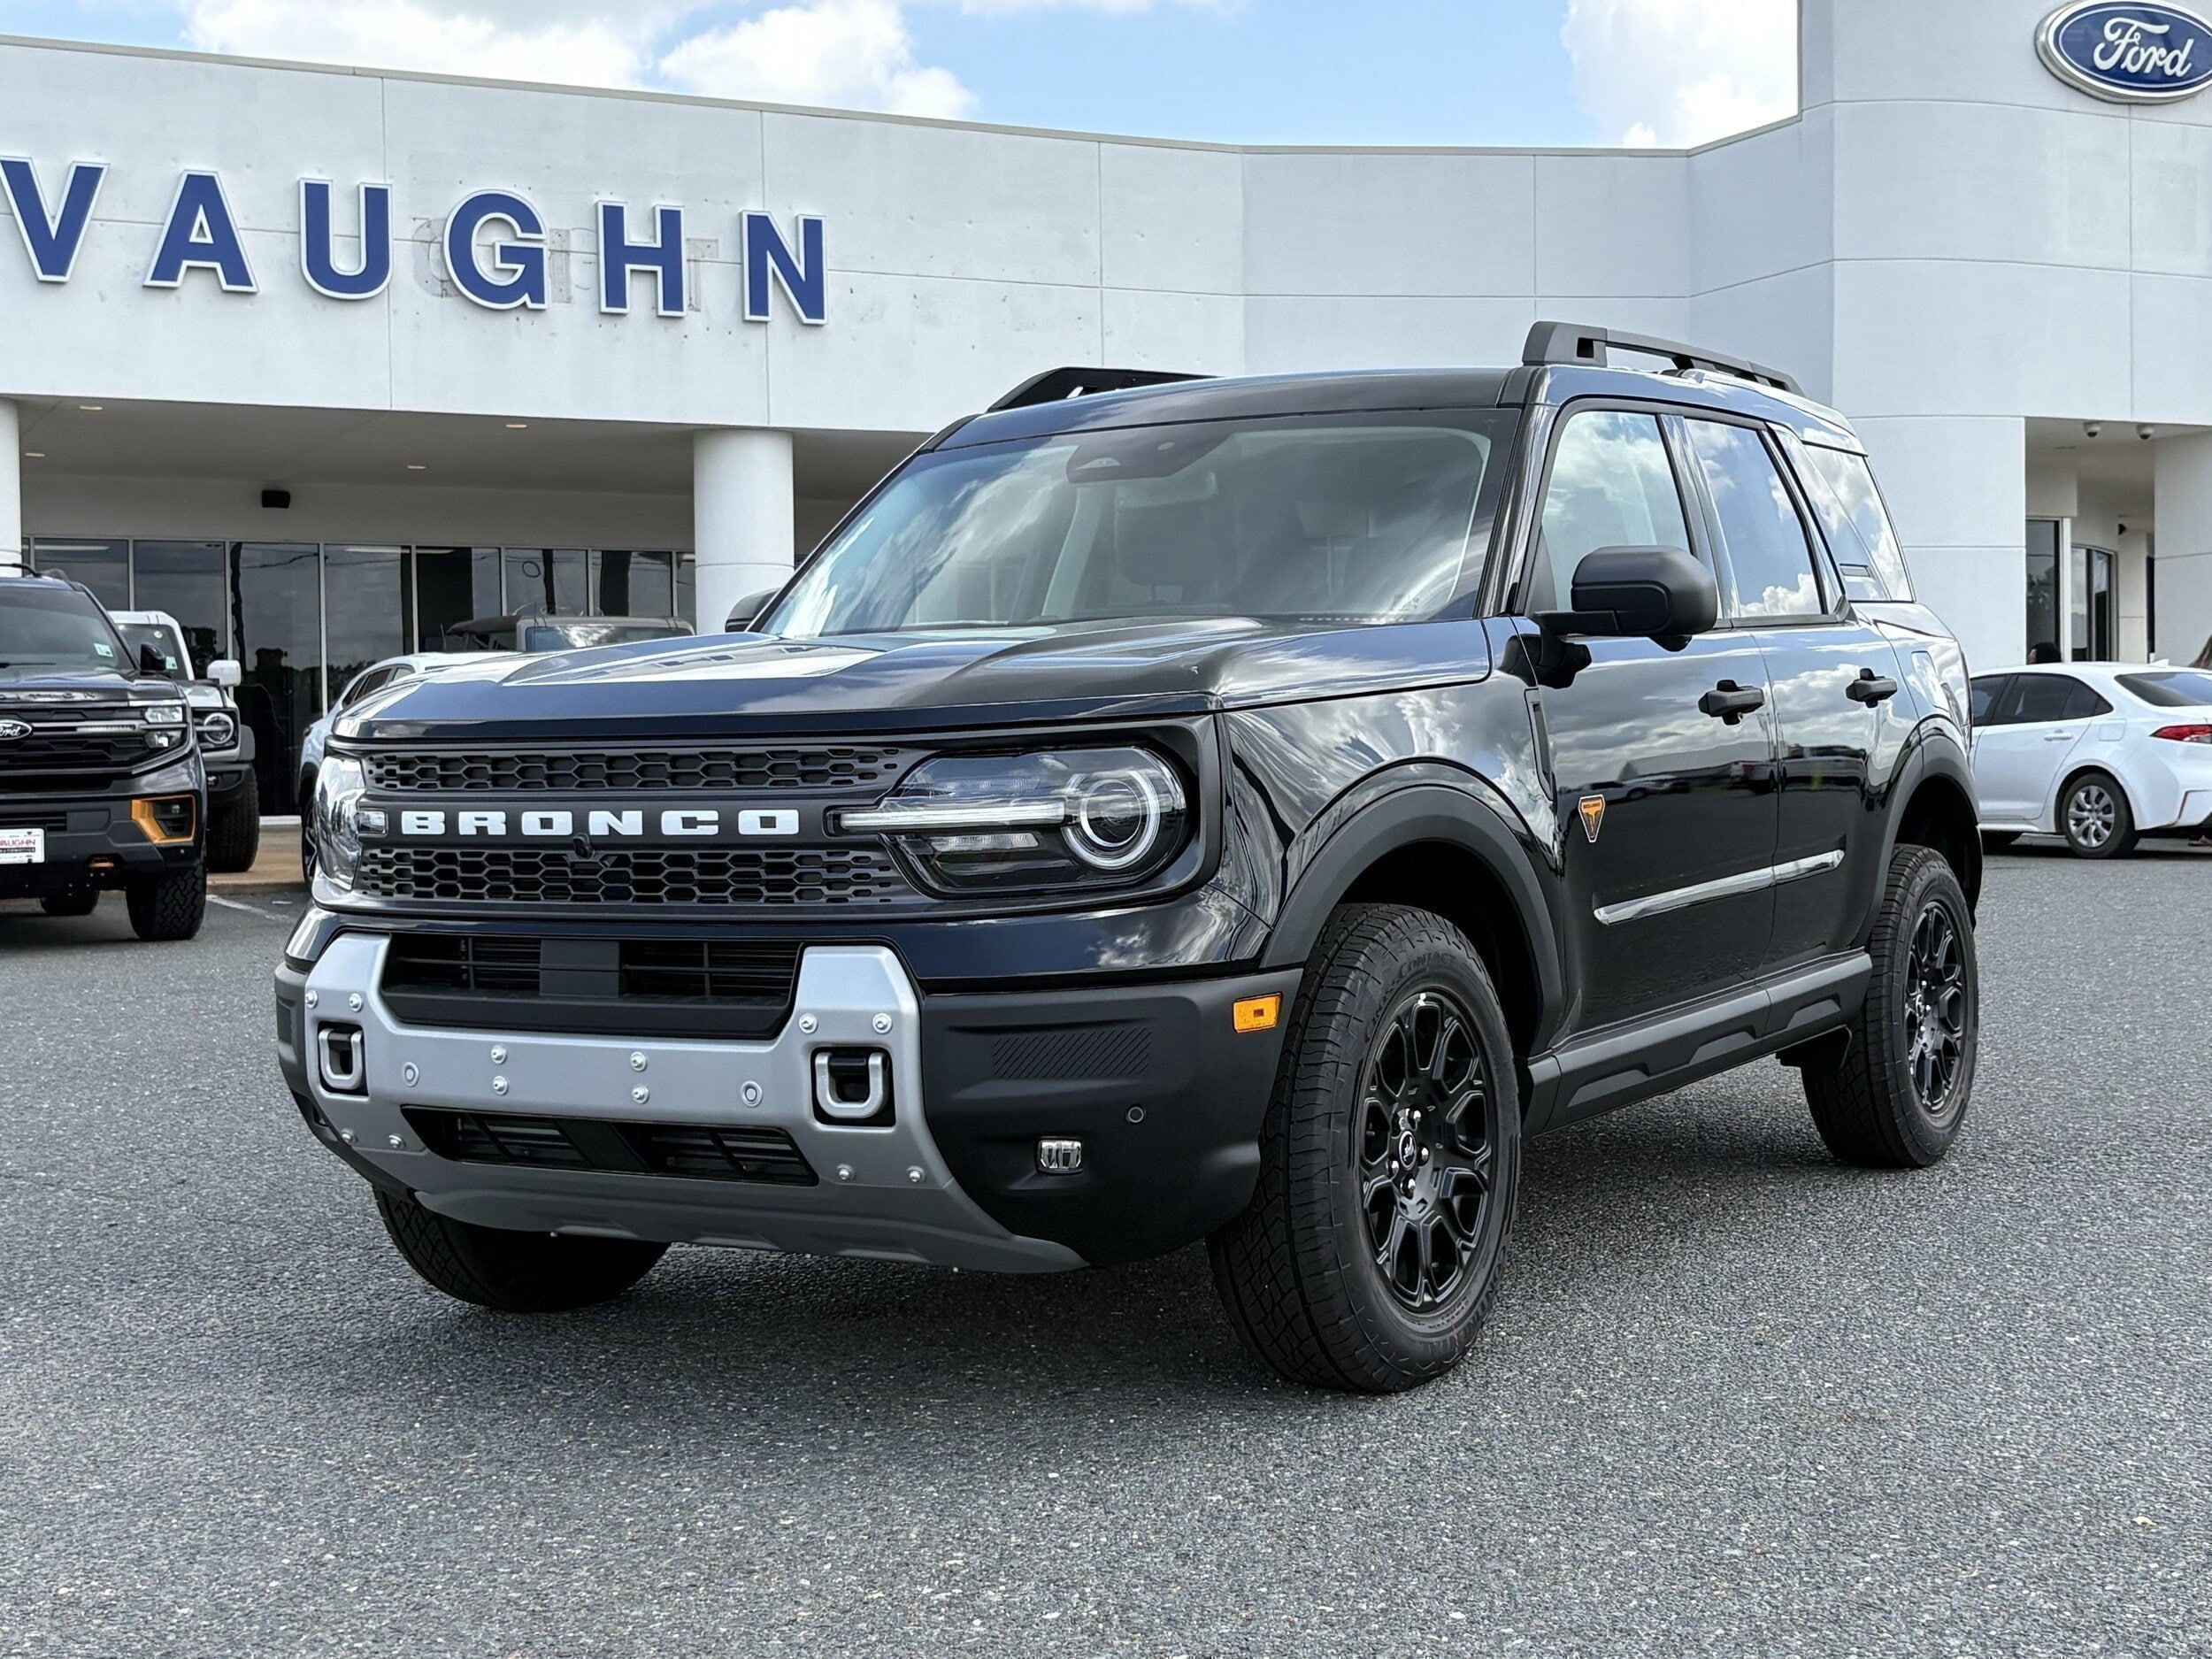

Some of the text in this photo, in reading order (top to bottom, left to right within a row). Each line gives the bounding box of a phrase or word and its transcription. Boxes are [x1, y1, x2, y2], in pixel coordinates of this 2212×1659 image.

[2093, 17, 2194, 78] Ford
[0, 156, 828, 326] VAUGHN
[401, 810, 799, 836] BRONCO
